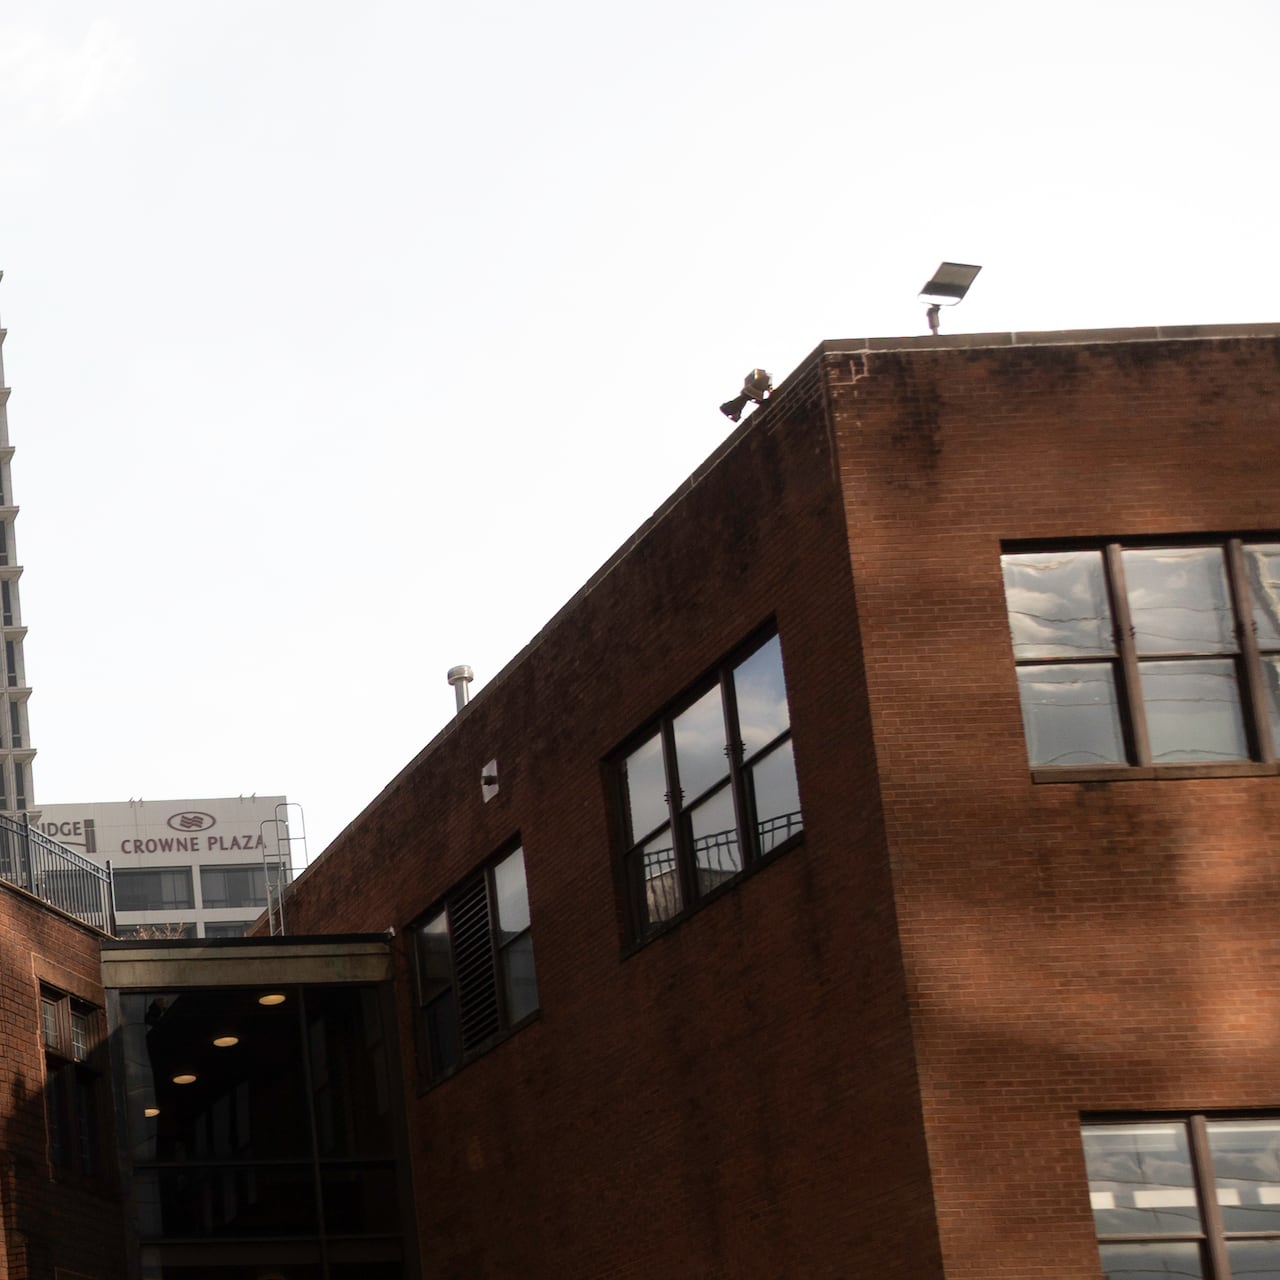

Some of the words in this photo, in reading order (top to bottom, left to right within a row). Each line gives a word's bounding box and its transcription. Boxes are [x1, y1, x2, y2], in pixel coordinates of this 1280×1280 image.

[37, 821, 82, 836] IDGE
[121, 837, 200, 854] CROWNE
[207, 835, 267, 851] PLAZA
